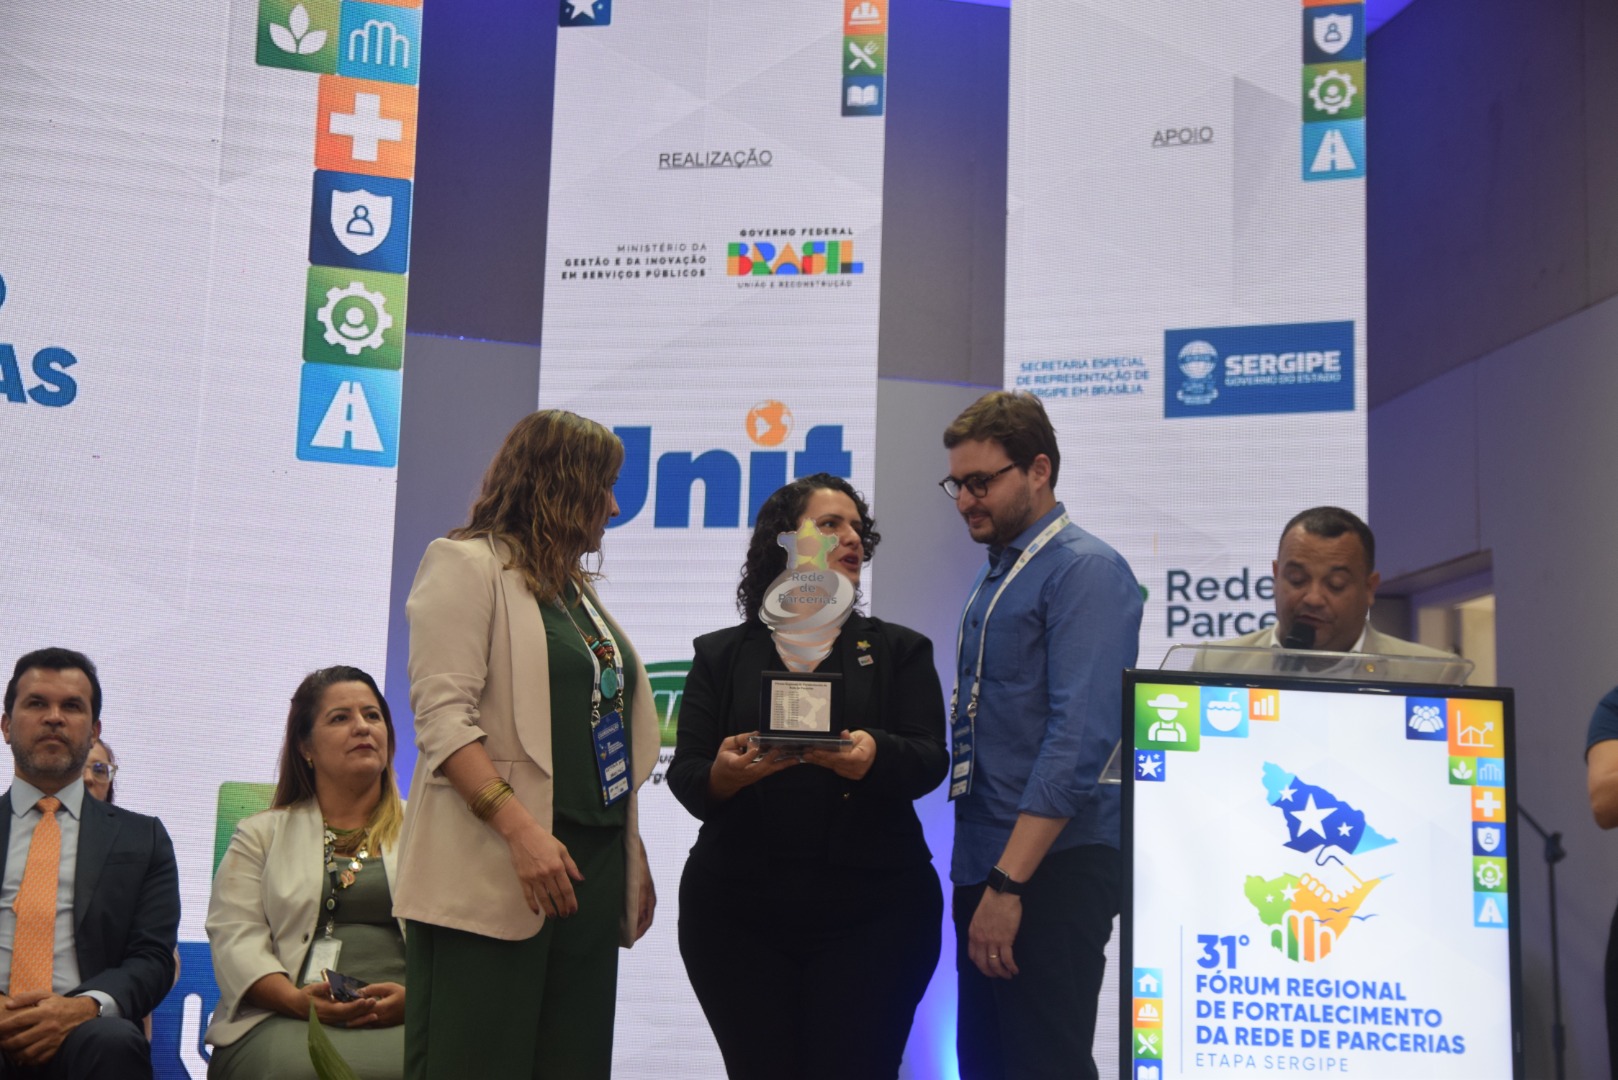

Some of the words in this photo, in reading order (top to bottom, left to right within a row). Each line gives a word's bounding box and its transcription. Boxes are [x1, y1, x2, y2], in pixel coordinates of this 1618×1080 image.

[1152, 127, 1214, 147] APOIO
[659, 148, 773, 169] REALIZAÇÃO
[740, 229, 796, 237] GOVERNO
[802, 227, 854, 236] FEDERAL
[617, 243, 687, 253] MINISTÉRIO
[692, 243, 707, 251] DA
[565, 257, 610, 267] GESTÃO
[615, 257, 621, 266] E
[627, 257, 641, 265] DA
[645, 254, 706, 266] INOVAÇÃO
[727, 240, 864, 276] BRASIL
[562, 271, 577, 280] EM
[582, 269, 641, 280] SERVIÇOS
[646, 267, 706, 278] PÚBLICOS
[738, 281, 767, 289] UNIÃO
[1021, 360, 1088, 371] SECRETARIA
[1093, 356, 1145, 369] ESPECIAL
[1225, 350, 1341, 376] SERGIPE
[1016, 376, 1030, 385] DE
[1034, 370, 1130, 384] REPRESENTAÇÃO
[1135, 370, 1149, 380] DE
[1072, 386, 1088, 396] EM
[1093, 383, 1144, 396] BRASÍLIA
[792, 572, 824, 581] Rede
[800, 583, 816, 592] de
[1167, 567, 1275, 602] Rede
[778, 594, 837, 604] Parcerias
[1196, 970, 1280, 995] FÓRUM
[1287, 978, 1406, 1001] REGIONAL
[1196, 1000, 1226, 1019] DE
[1233, 1002, 1442, 1028] FORTALECIMENTO
[1196, 1026, 1229, 1045] DA
[1235, 1027, 1294, 1047] REDE
[1301, 1030, 1330, 1049] DE
[1337, 1031, 1465, 1054] PARCERIAS
[1196, 1053, 1256, 1069] ETAPA
[1264, 1055, 1349, 1072] SERGIPE
